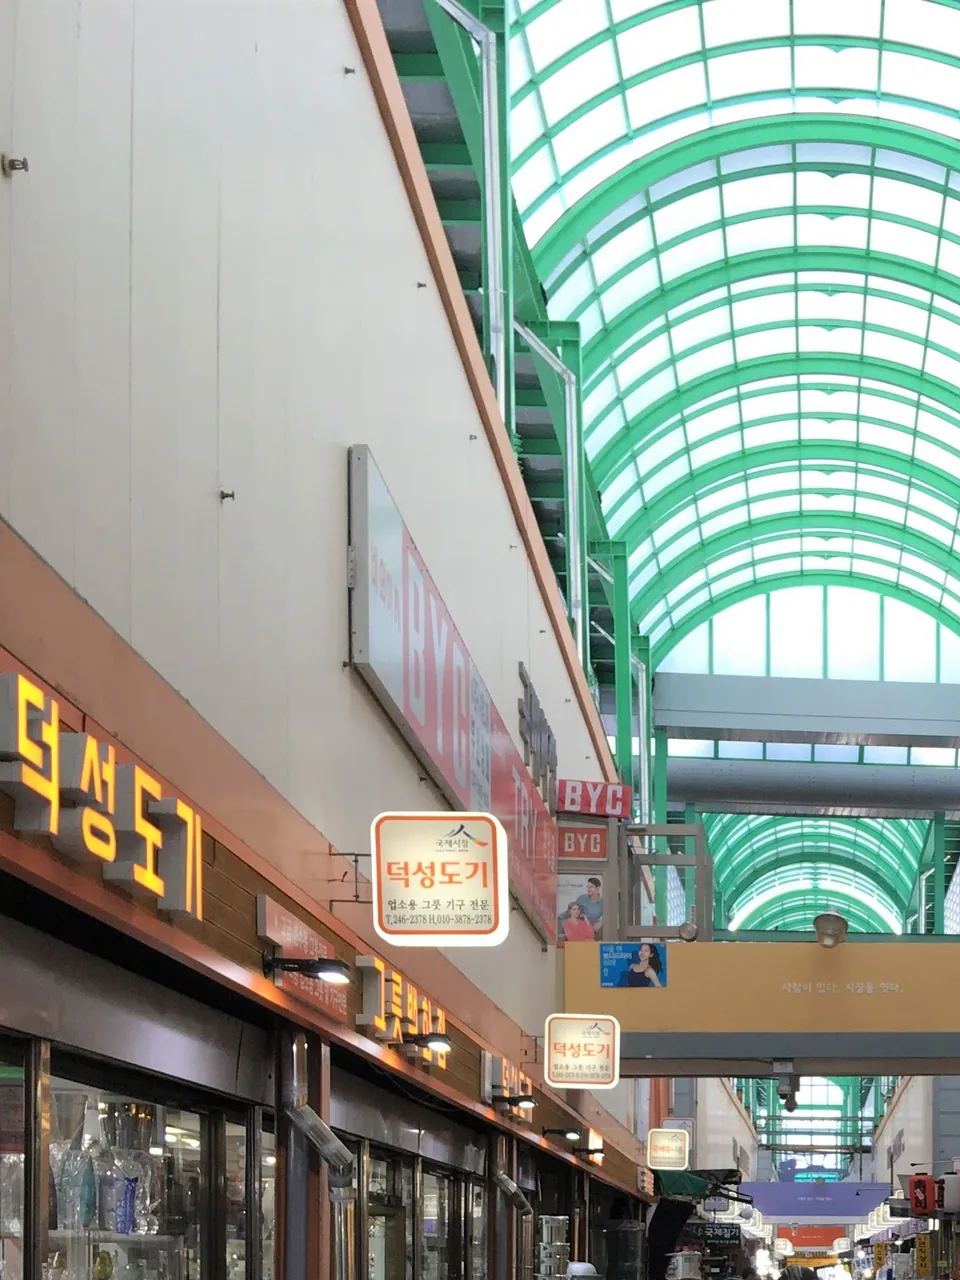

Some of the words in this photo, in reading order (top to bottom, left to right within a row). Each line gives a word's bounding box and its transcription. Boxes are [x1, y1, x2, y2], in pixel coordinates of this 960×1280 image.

[408, 549, 468, 789] BYC
[17, 672, 203, 922] 덕성도기
[564, 779, 623, 816] BYC
[512, 766, 538, 863] TRY
[435, 839, 469, 848] 국제시장
[564, 832, 600, 853] BYC
[386, 861, 488, 889] 덕성도기
[388, 899, 417, 911] 업소용
[446, 899, 465, 911] 기구
[469, 899, 489, 911] 전문
[553, 1042, 610, 1059] 덕성도기
